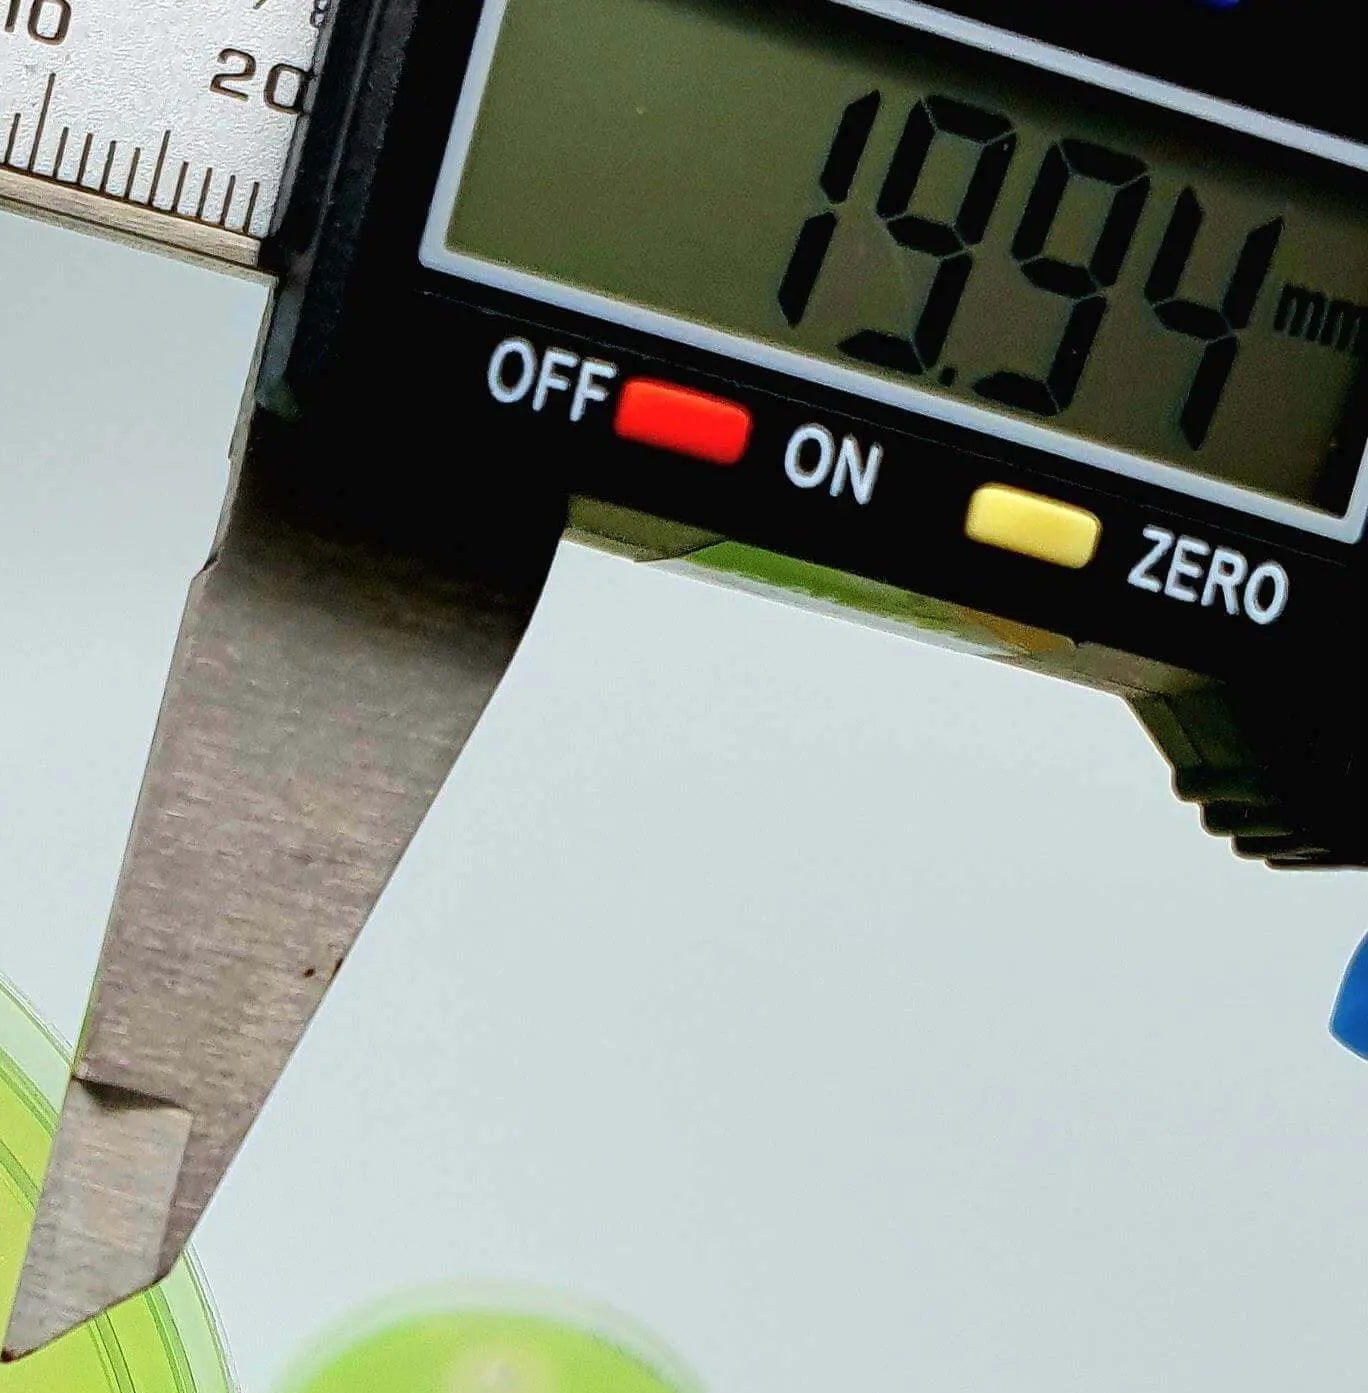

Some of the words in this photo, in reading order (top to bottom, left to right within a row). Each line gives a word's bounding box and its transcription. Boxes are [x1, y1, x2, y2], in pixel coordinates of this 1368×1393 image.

[209, 47, 310, 116] 20
[777, 88, 1285, 451] 19.94
[1273, 281, 1368, 353] mm
[487, 337, 618, 424] OFF
[784, 422, 885, 506] ON
[1126, 523, 1291, 627] ZERO
